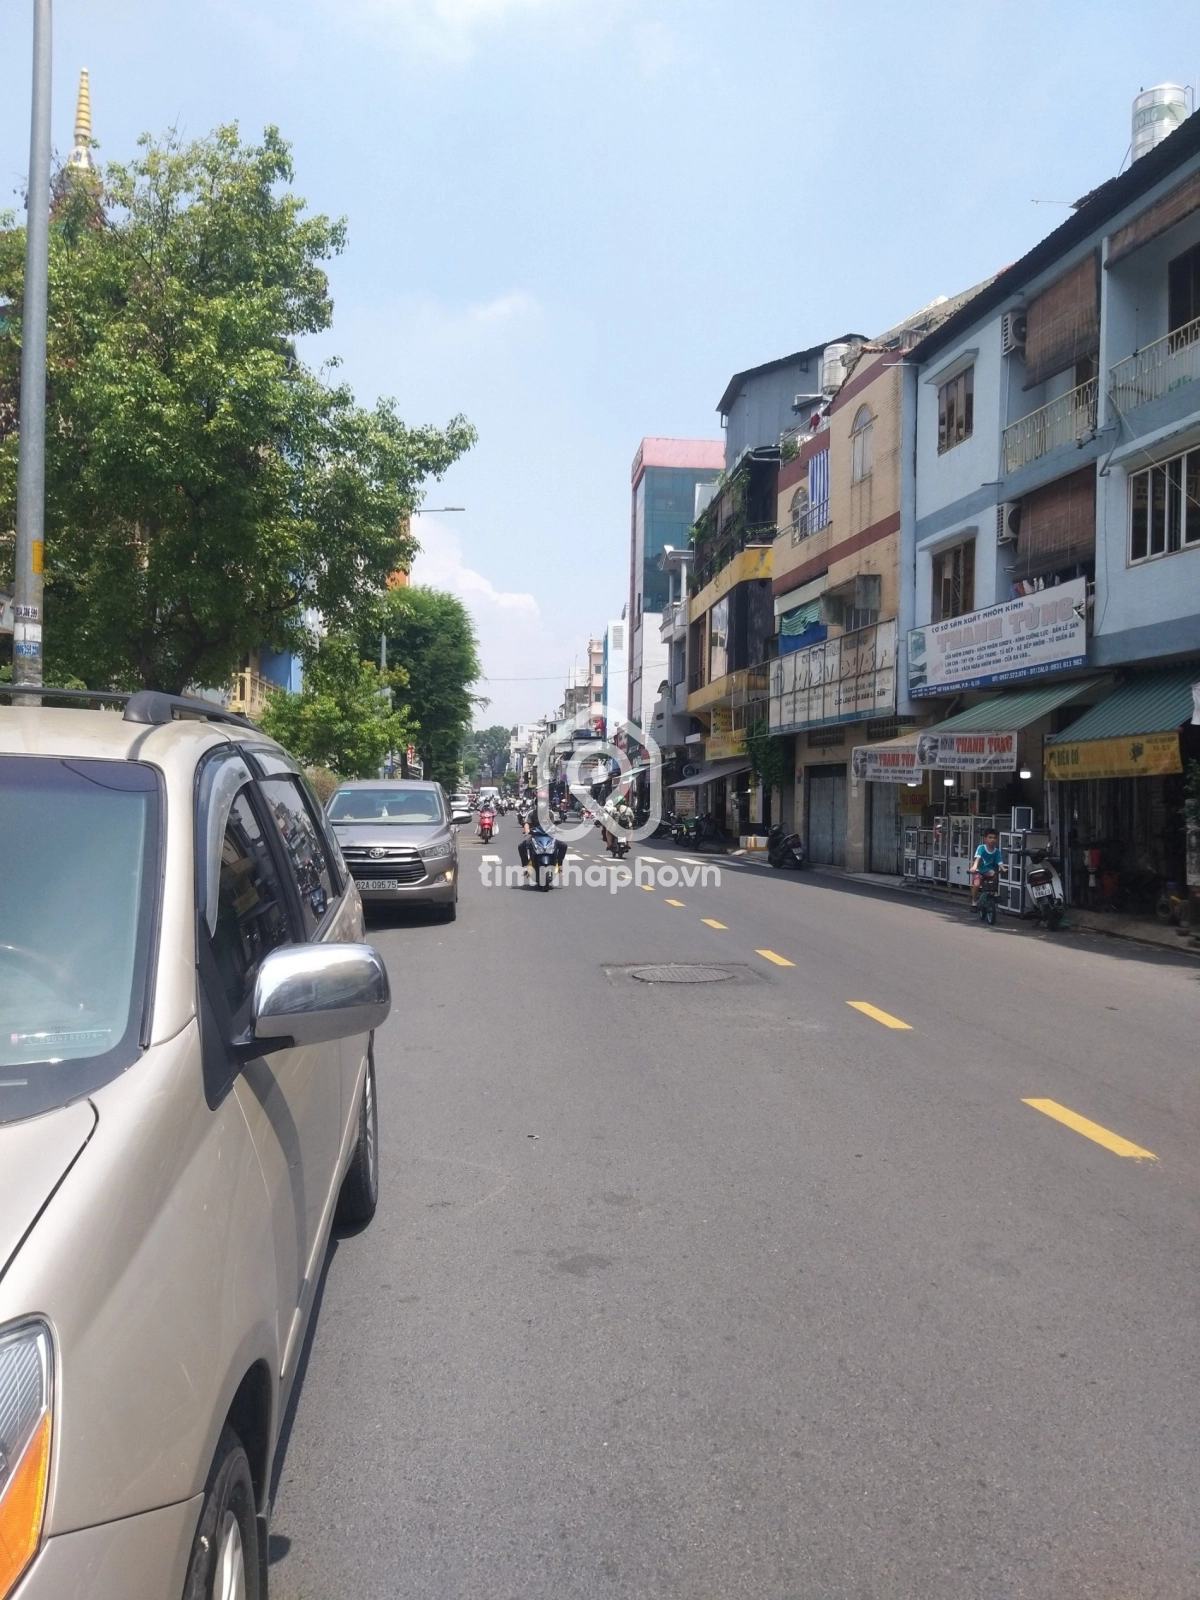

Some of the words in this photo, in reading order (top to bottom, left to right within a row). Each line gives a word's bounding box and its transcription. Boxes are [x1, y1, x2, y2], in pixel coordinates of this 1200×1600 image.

[936, 617, 1002, 654] THANH
[1008, 596, 1074, 634] TÙNG
[956, 737, 985, 754] THANH
[879, 753, 900, 767] THANH
